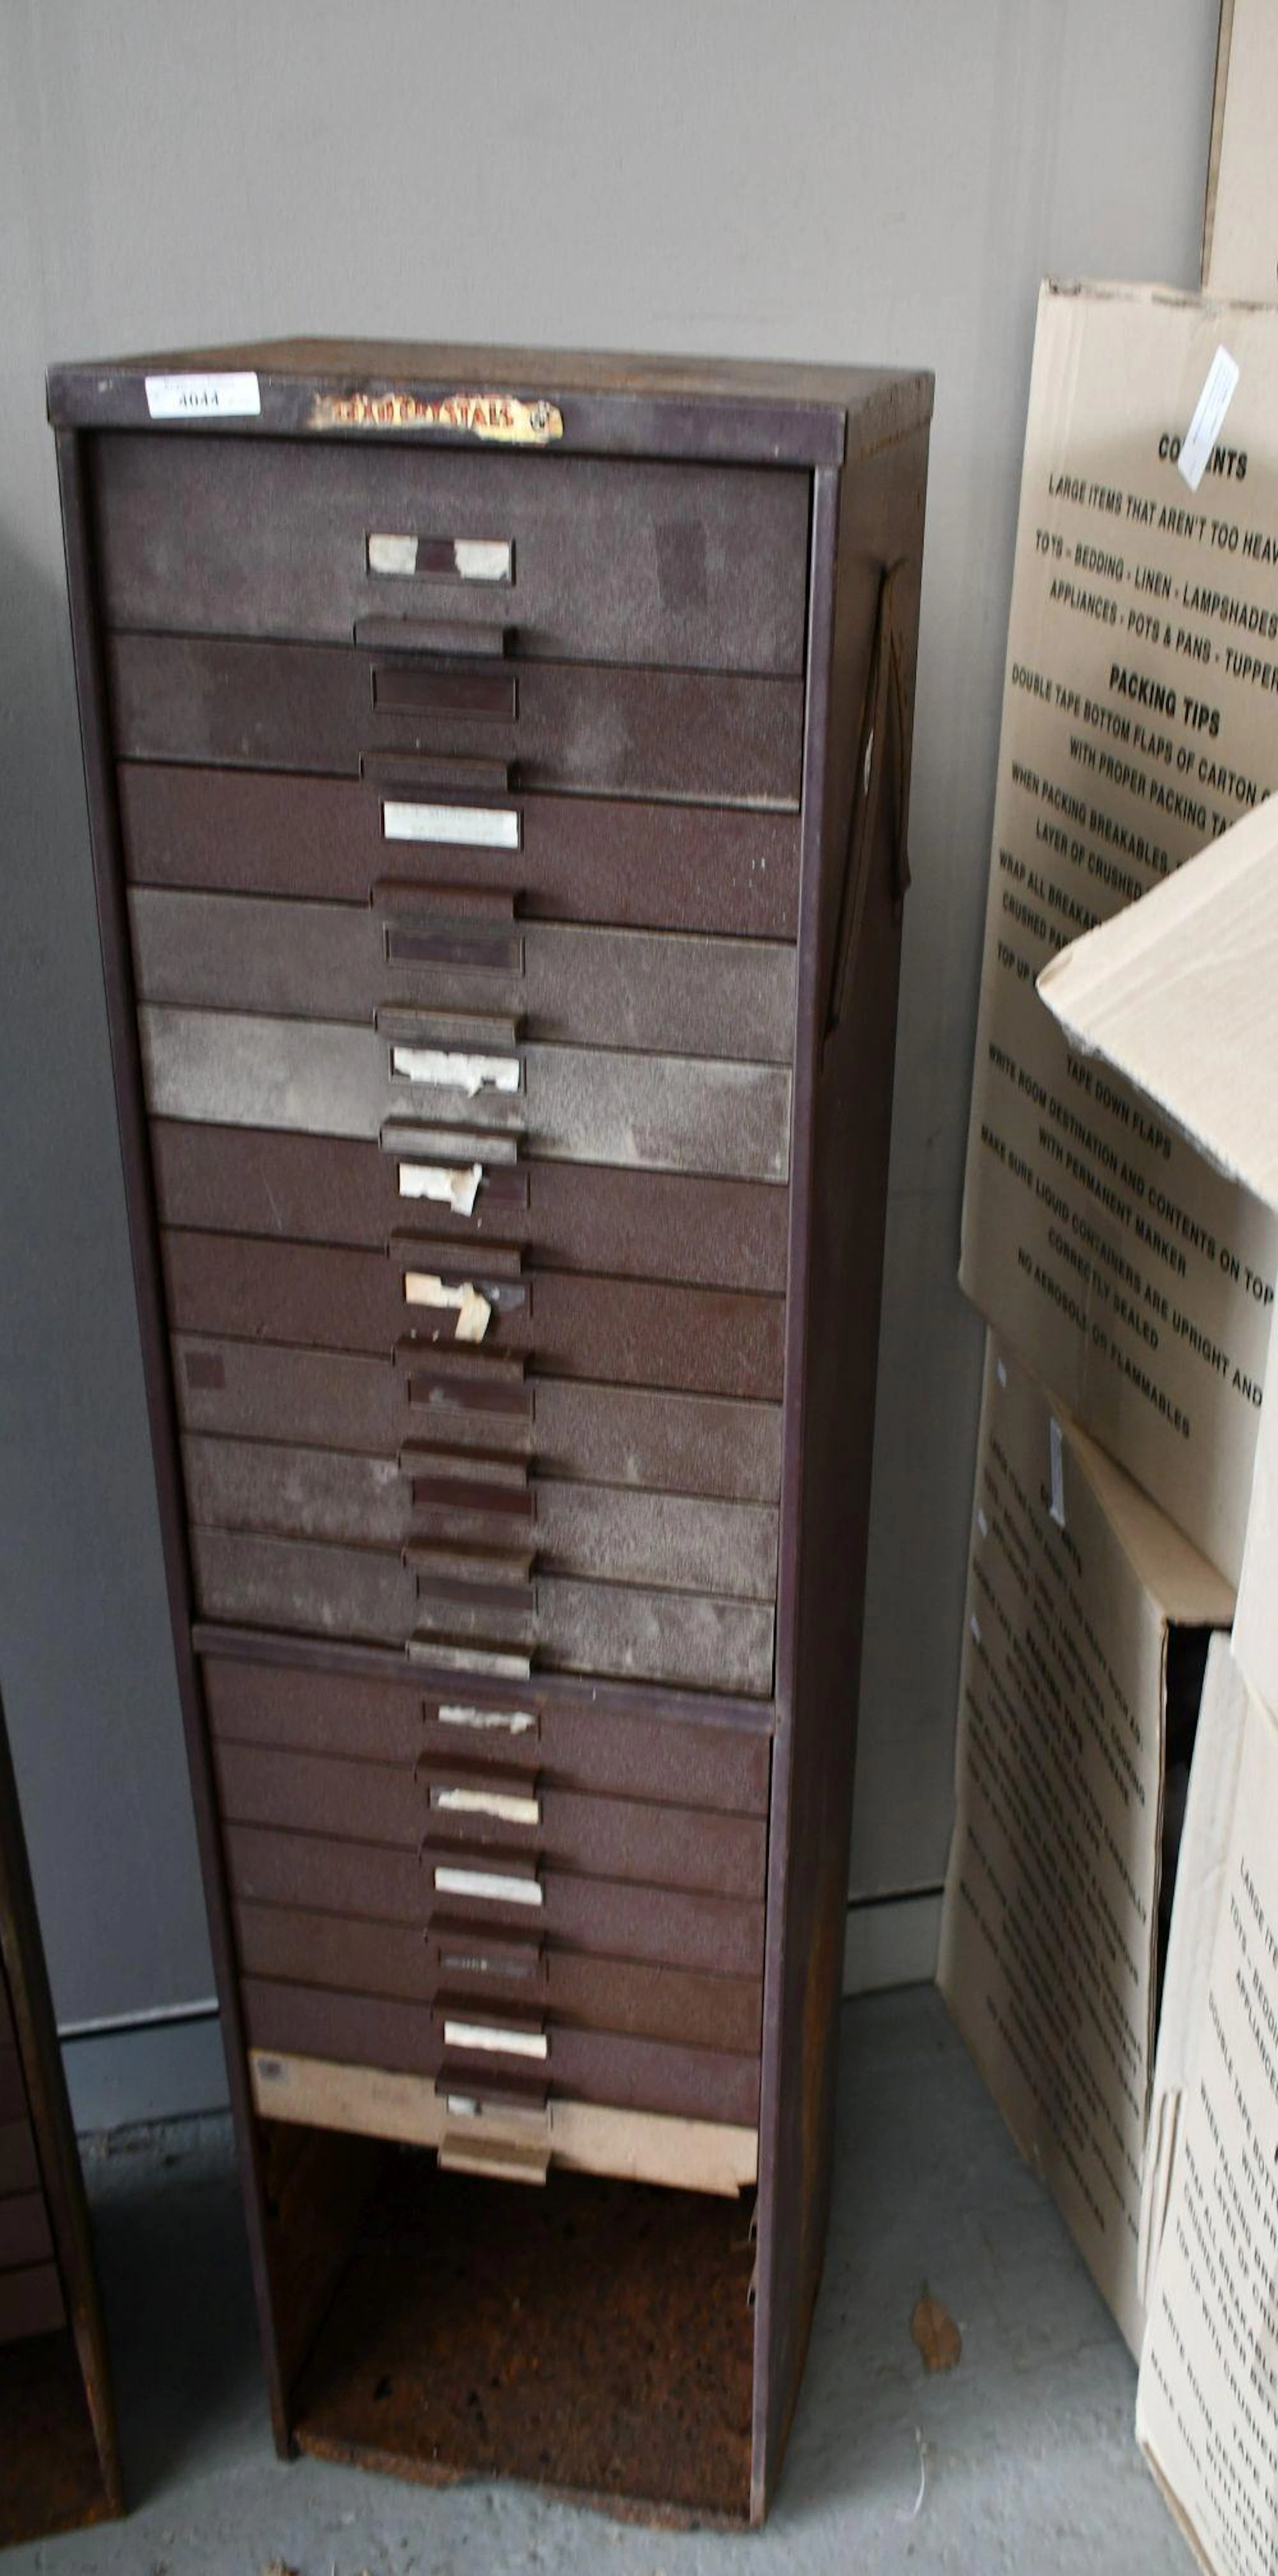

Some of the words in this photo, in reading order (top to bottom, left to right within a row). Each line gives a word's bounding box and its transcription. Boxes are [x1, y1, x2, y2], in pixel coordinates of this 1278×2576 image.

[1158, 433, 1247, 480] CONTS
[1049, 471, 1085, 505] LARGE
[1089, 484, 1122, 515] ITEMS
[1126, 495, 1156, 526] THAT
[1158, 506, 1206, 542] AREN'T
[1211, 518, 1238, 550] TOO
[1035, 529, 1063, 559] TOYS
[1074, 542, 1124, 582] BEDDING
[1134, 564, 1172, 598] LINEN
[1182, 581, 1278, 640] LAMPSHADES
[1050, 578, 1117, 627] APPLIANCES
[1128, 609, 1160, 644] POTS
[1163, 625, 1171, 647] &
[1175, 628, 1211, 664] PANS
[1012, 663, 1051, 702] DOUBLE
[1055, 683, 1080, 716] TAPE
[1083, 698, 1130, 745] BOTTOM
[1133, 723, 1172, 764] FLAPS
[1176, 747, 1195, 774] OF
[1198, 756, 1257, 808] CARTON
[1109, 662, 1176, 716] PACKING
[1183, 696, 1219, 737] TIPS
[1012, 760, 1039, 796] WHEN
[1042, 778, 1086, 825] PACKING
[1070, 736, 1096, 770] WITH
[1098, 752, 1146, 798] PROPER
[1150, 778, 1206, 831] PACKING
[1000, 849, 1026, 881] WRAP
[1028, 870, 1044, 898] ALL
[1036, 818, 1068, 857] LAYER
[1070, 839, 1084, 867] OF
[1088, 851, 1142, 902] CRUSHED
[1003, 888, 1046, 940] CRUSHED
[998, 939, 1014, 971] TOP
[1017, 957, 1030, 981] UP
[1067, 1054, 1093, 1094] TAPE
[1095, 1080, 1130, 1125] DOWN
[1133, 1112, 1172, 1159] FLAPS
[989, 1042, 1015, 1083] WRITE
[1018, 1067, 1047, 1109] ROOM
[1050, 1095, 1118, 1172] DESTINATION
[1121, 1162, 1145, 1197] AND
[1149, 1186, 1215, 1262] CONTENTS
[1220, 1248, 1241, 1282] ON
[1245, 1267, 1274, 1305] TOP
[1039, 1125, 1063, 1163] WITH
[1066, 1151, 1132, 1227] PERMANENT
[1135, 1213, 1186, 1279] MARKER
[981, 1124, 1006, 1163] MAKE
[1008, 1149, 1033, 1190] SURE
[1035, 1175, 1069, 1224] LIQUID
[1072, 1212, 1141, 1295] CONTAINERS
[1144, 1283, 1169, 1322] ARE
[1172, 1309, 1229, 1378] UPRIGHT
[1232, 1368, 1263, 1408] AND
[1048, 1225, 1110, 1301] CORRECTLY
[1113, 1290, 1159, 1351] SEALED
[1018, 1245, 1032, 1276] NO
[1092, 1321, 1107, 1352] OR
[1111, 1341, 1190, 1439] FLAMMABLES
[1240, 1854, 1264, 1933] LARGE
